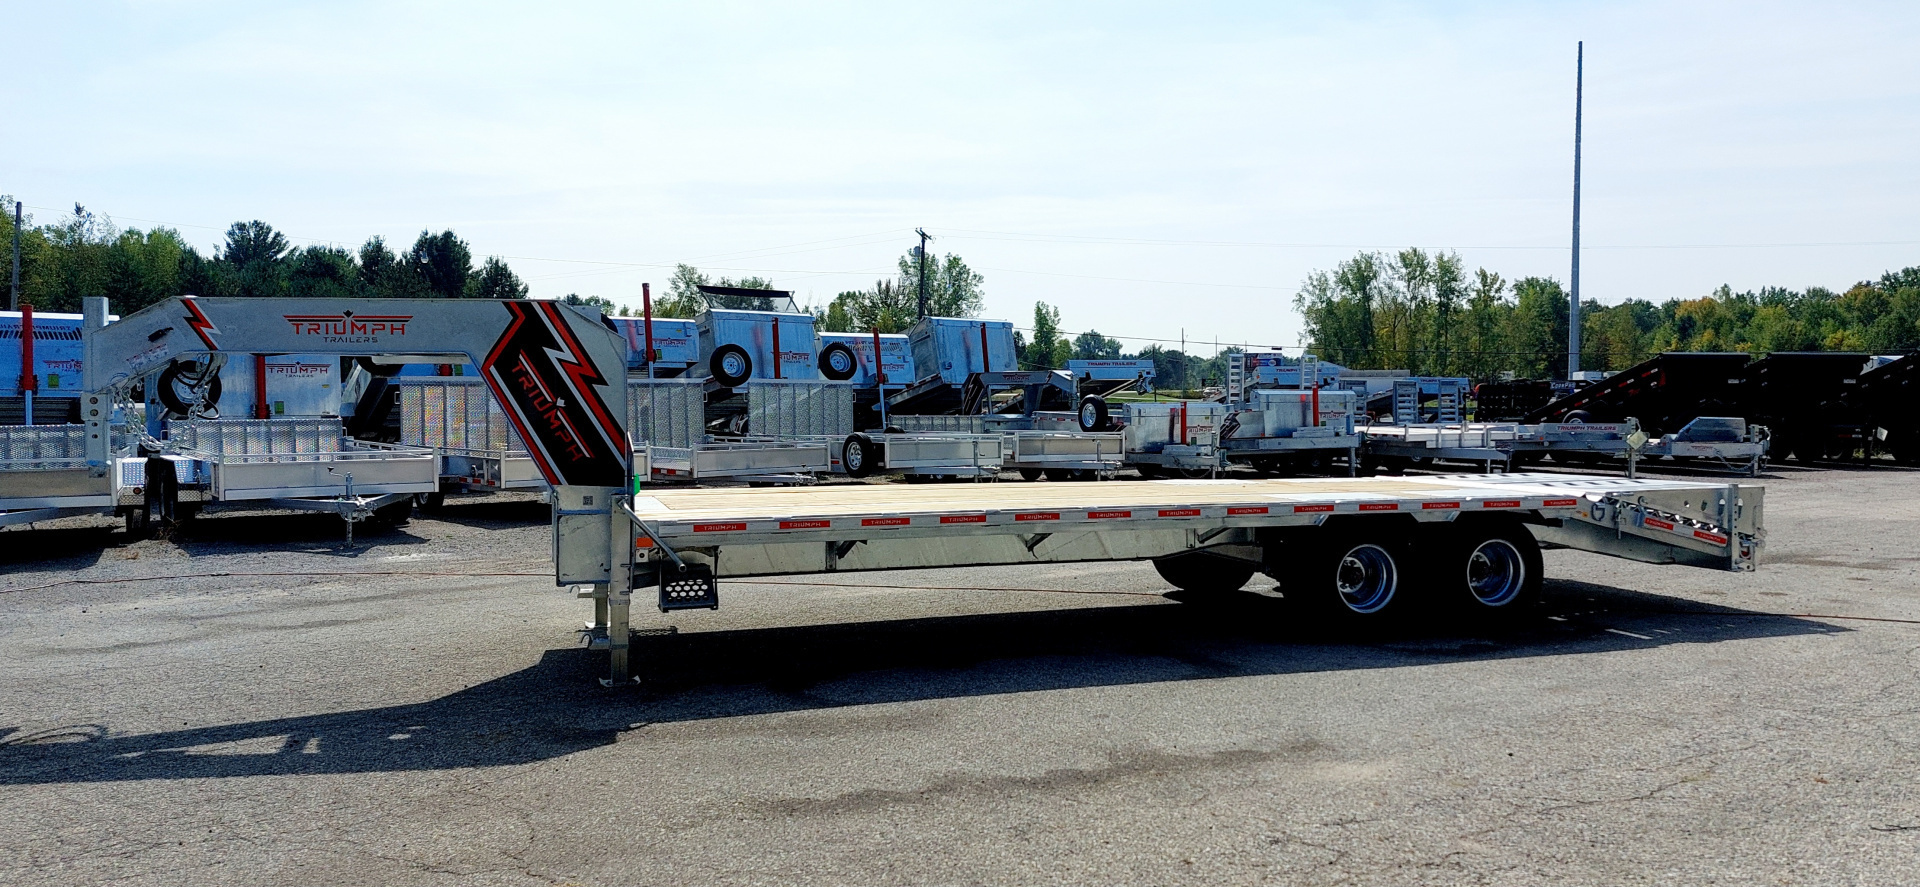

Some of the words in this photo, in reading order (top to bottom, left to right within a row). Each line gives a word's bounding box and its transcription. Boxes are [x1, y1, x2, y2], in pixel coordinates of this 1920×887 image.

[290, 321, 406, 335] TRIUMPH
[268, 366, 328, 374] TRIUMPH
[511, 360, 584, 462] TRIUMPH
